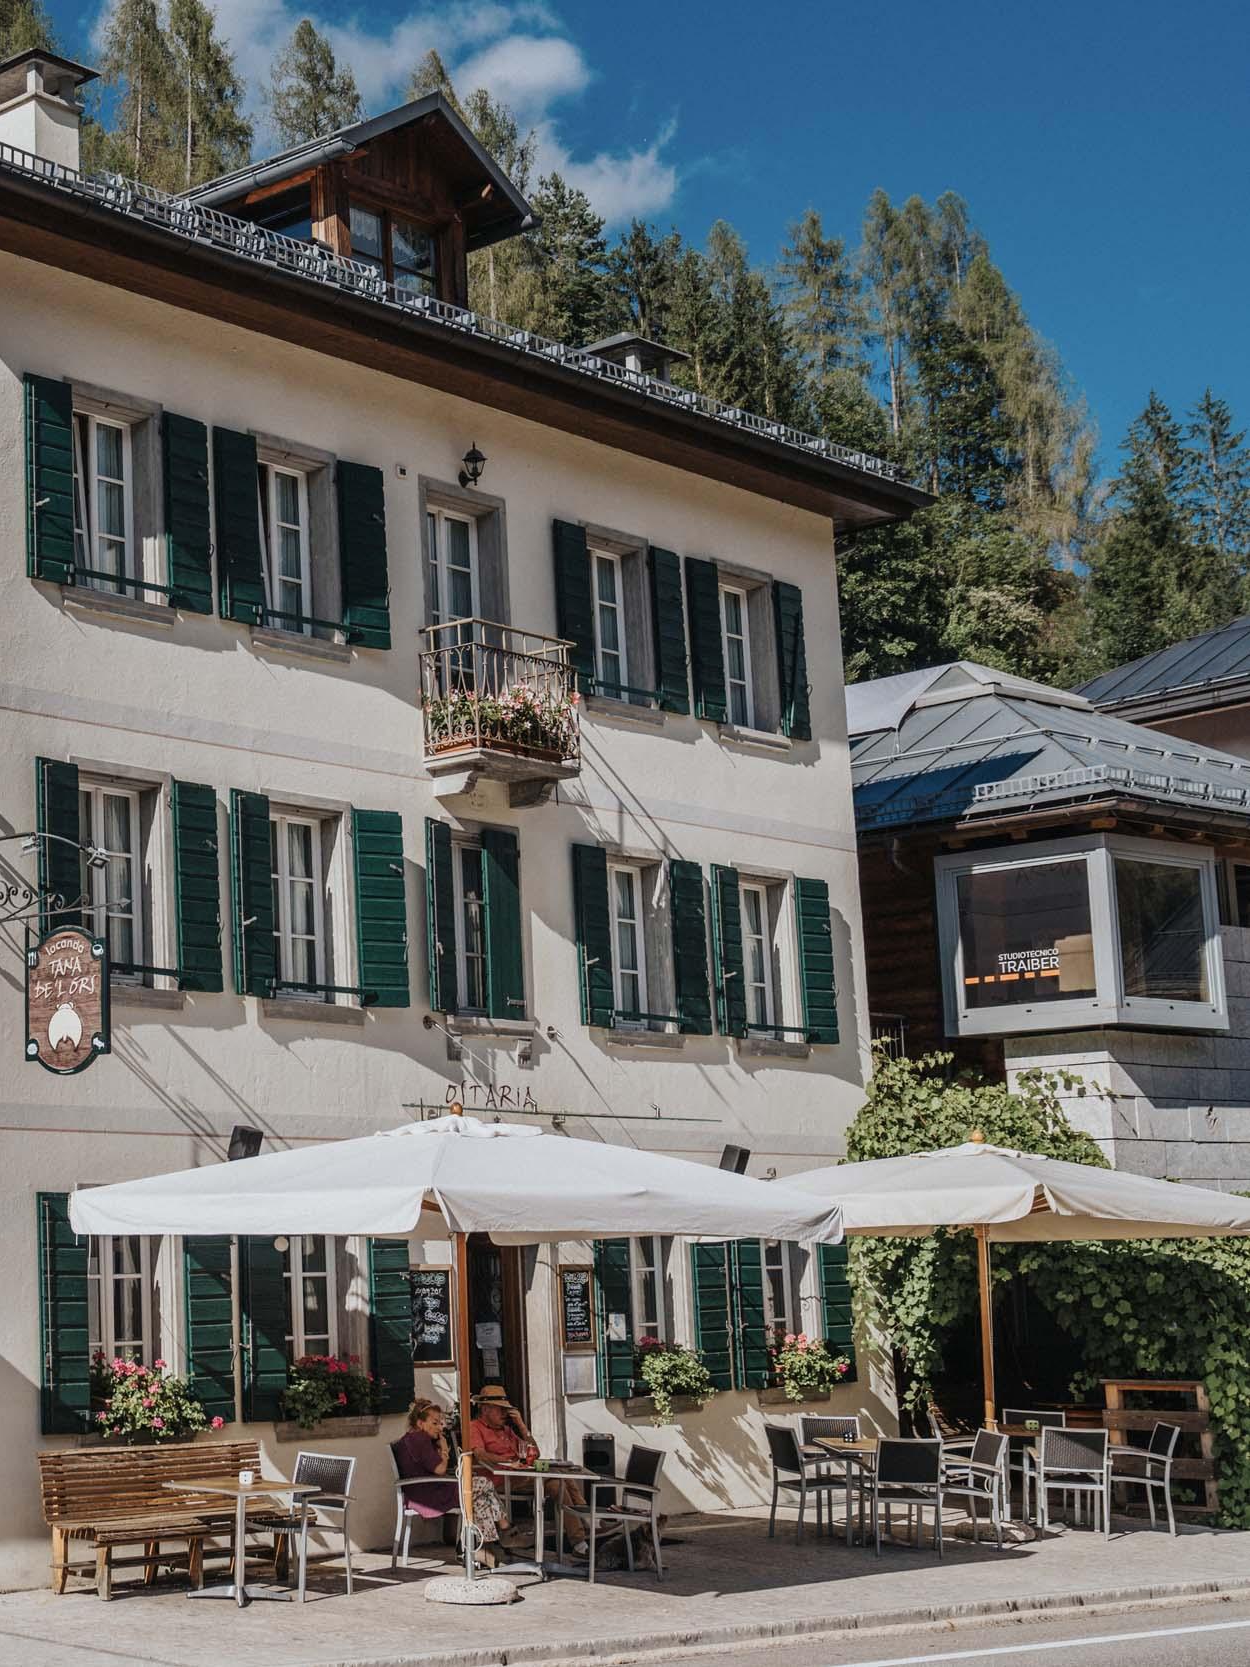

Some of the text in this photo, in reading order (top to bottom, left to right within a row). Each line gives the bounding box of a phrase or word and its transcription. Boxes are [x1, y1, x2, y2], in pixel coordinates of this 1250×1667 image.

[45, 939, 85, 956] locanda
[997, 947, 1060, 961] STUDIOTECNICO
[48, 955, 82, 979] TANA
[998, 956, 1060, 974] TRAIBER
[445, 1079, 538, 1110] OSTARIA
